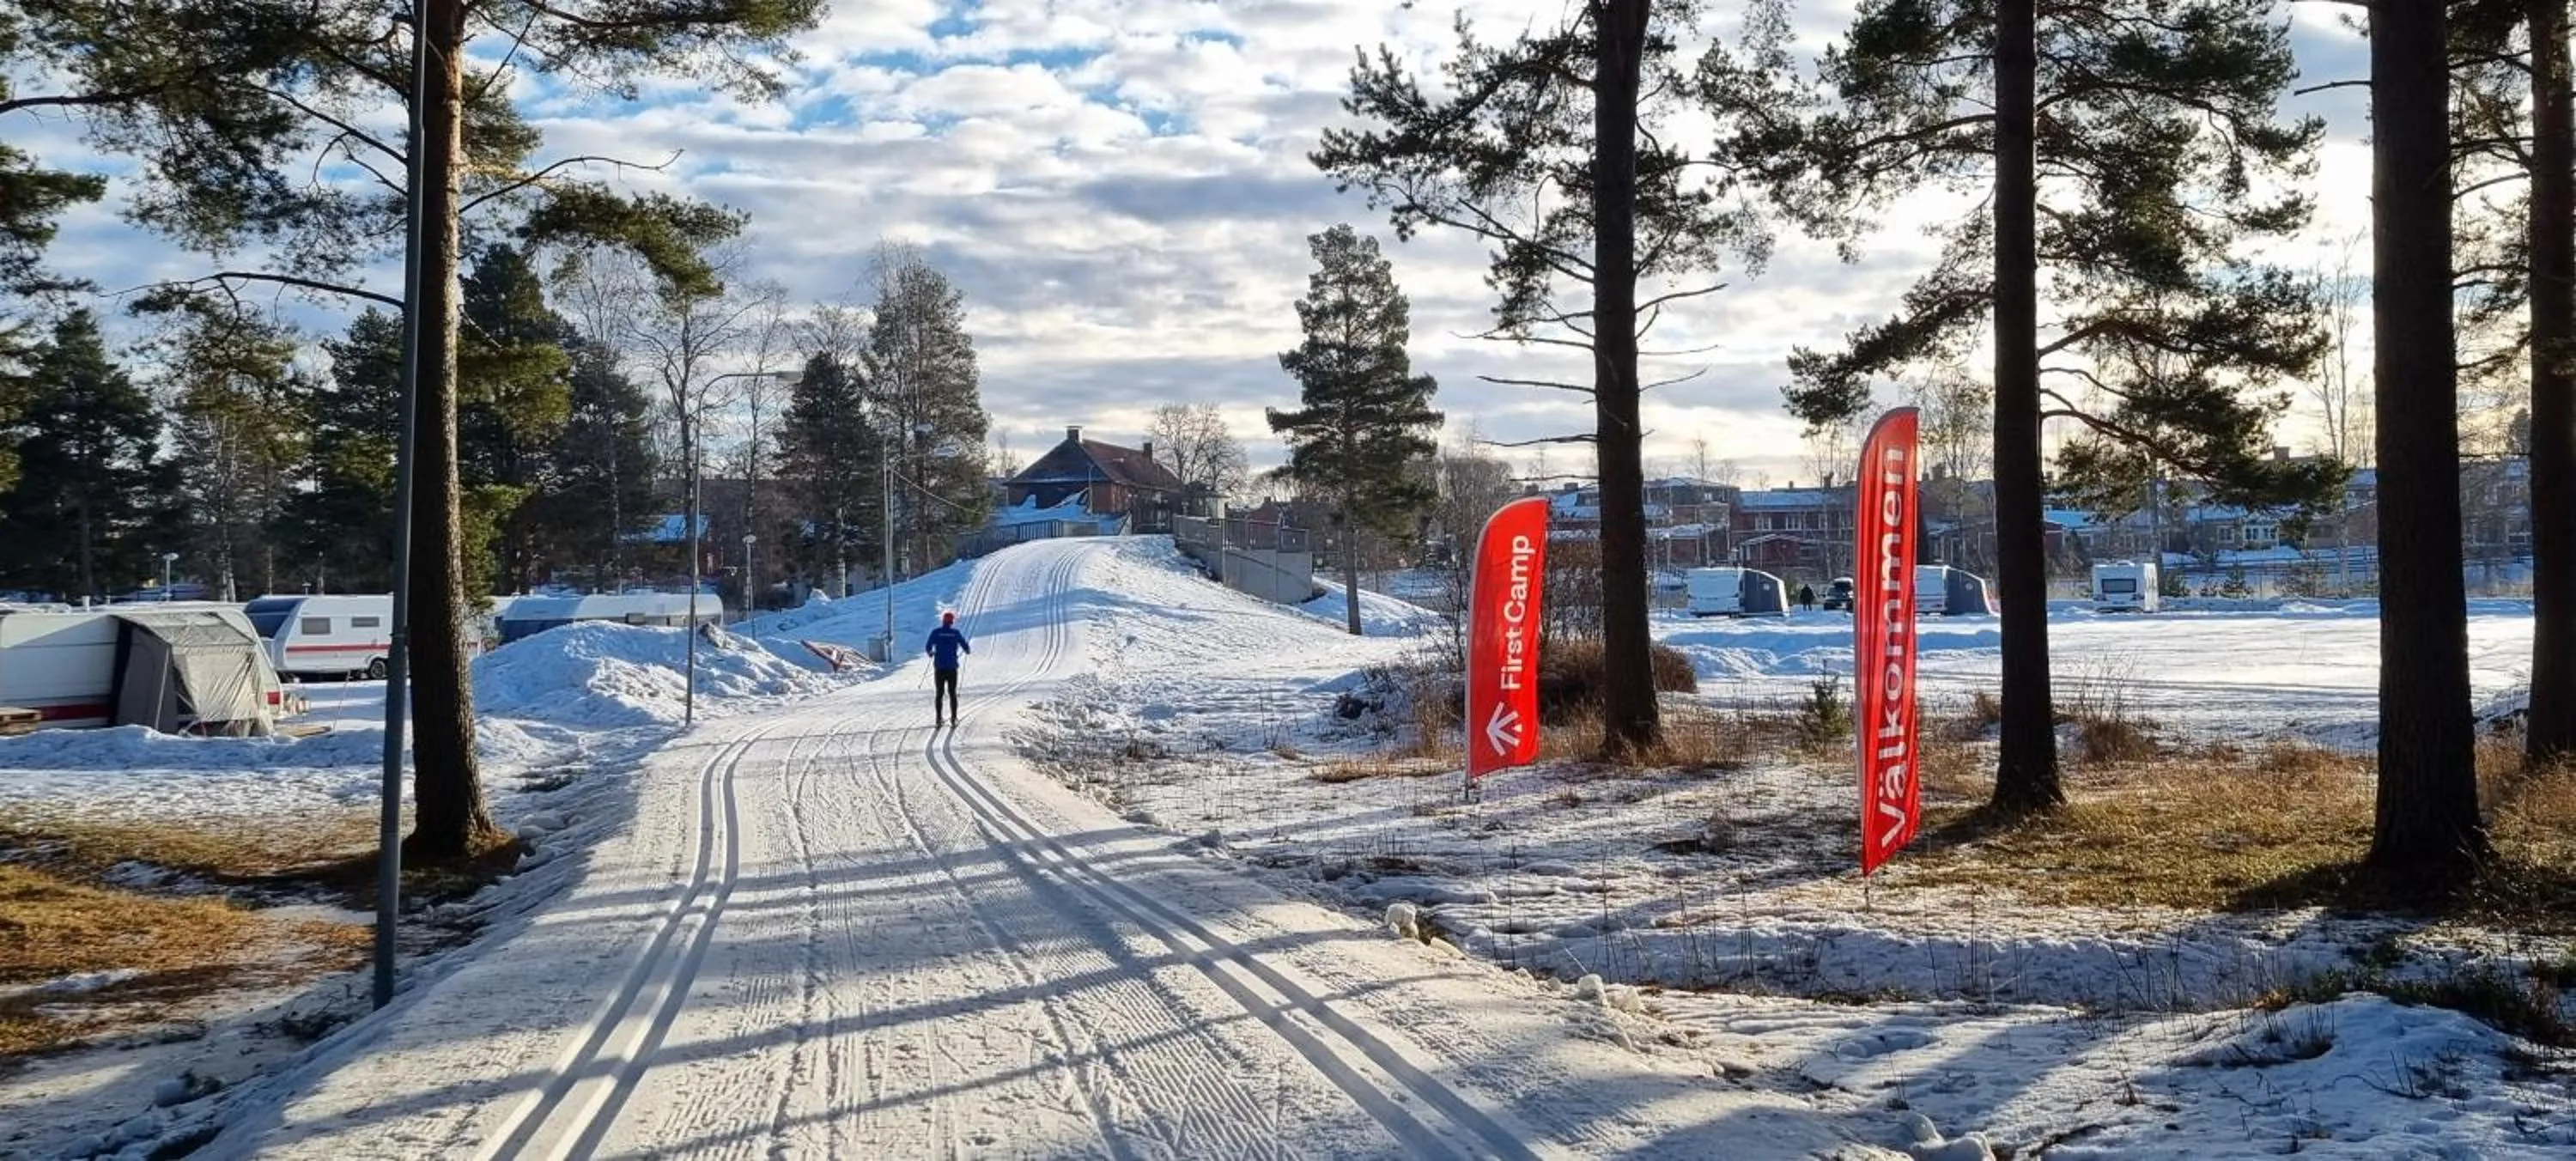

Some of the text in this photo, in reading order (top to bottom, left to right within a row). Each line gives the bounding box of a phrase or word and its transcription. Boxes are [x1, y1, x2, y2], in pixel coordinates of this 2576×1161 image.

[1500, 534, 1536, 690] First Camp
[1878, 447, 1907, 848] Välkommen
